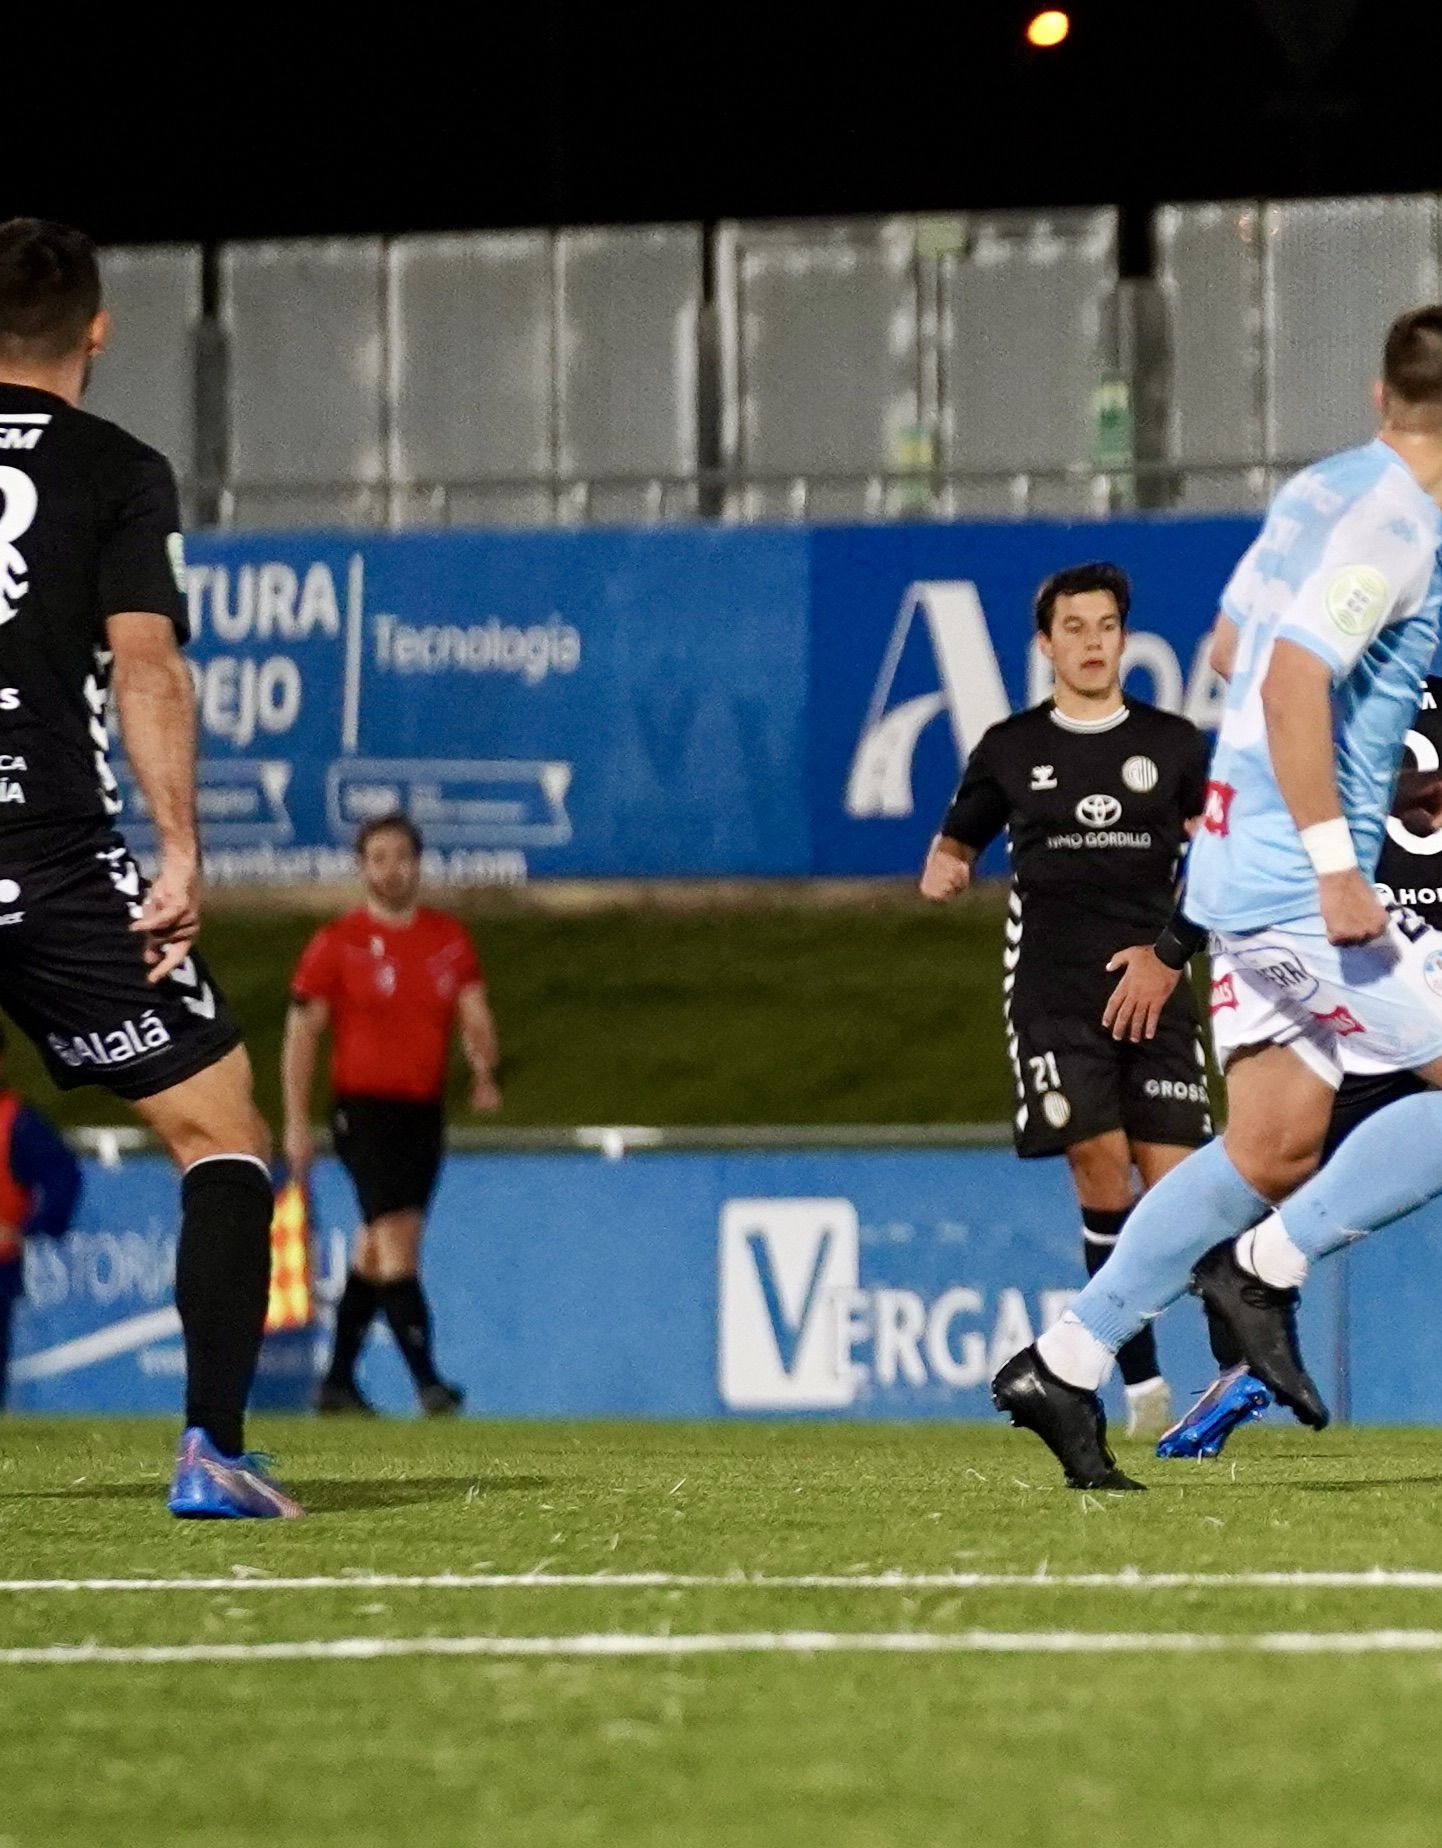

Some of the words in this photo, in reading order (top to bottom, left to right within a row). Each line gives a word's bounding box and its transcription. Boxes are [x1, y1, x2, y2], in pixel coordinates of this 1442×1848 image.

[1085, 831, 1152, 849] GORDILLO
[72, 1008, 171, 1065] Alalá
[1028, 1050, 1062, 1094] 21
